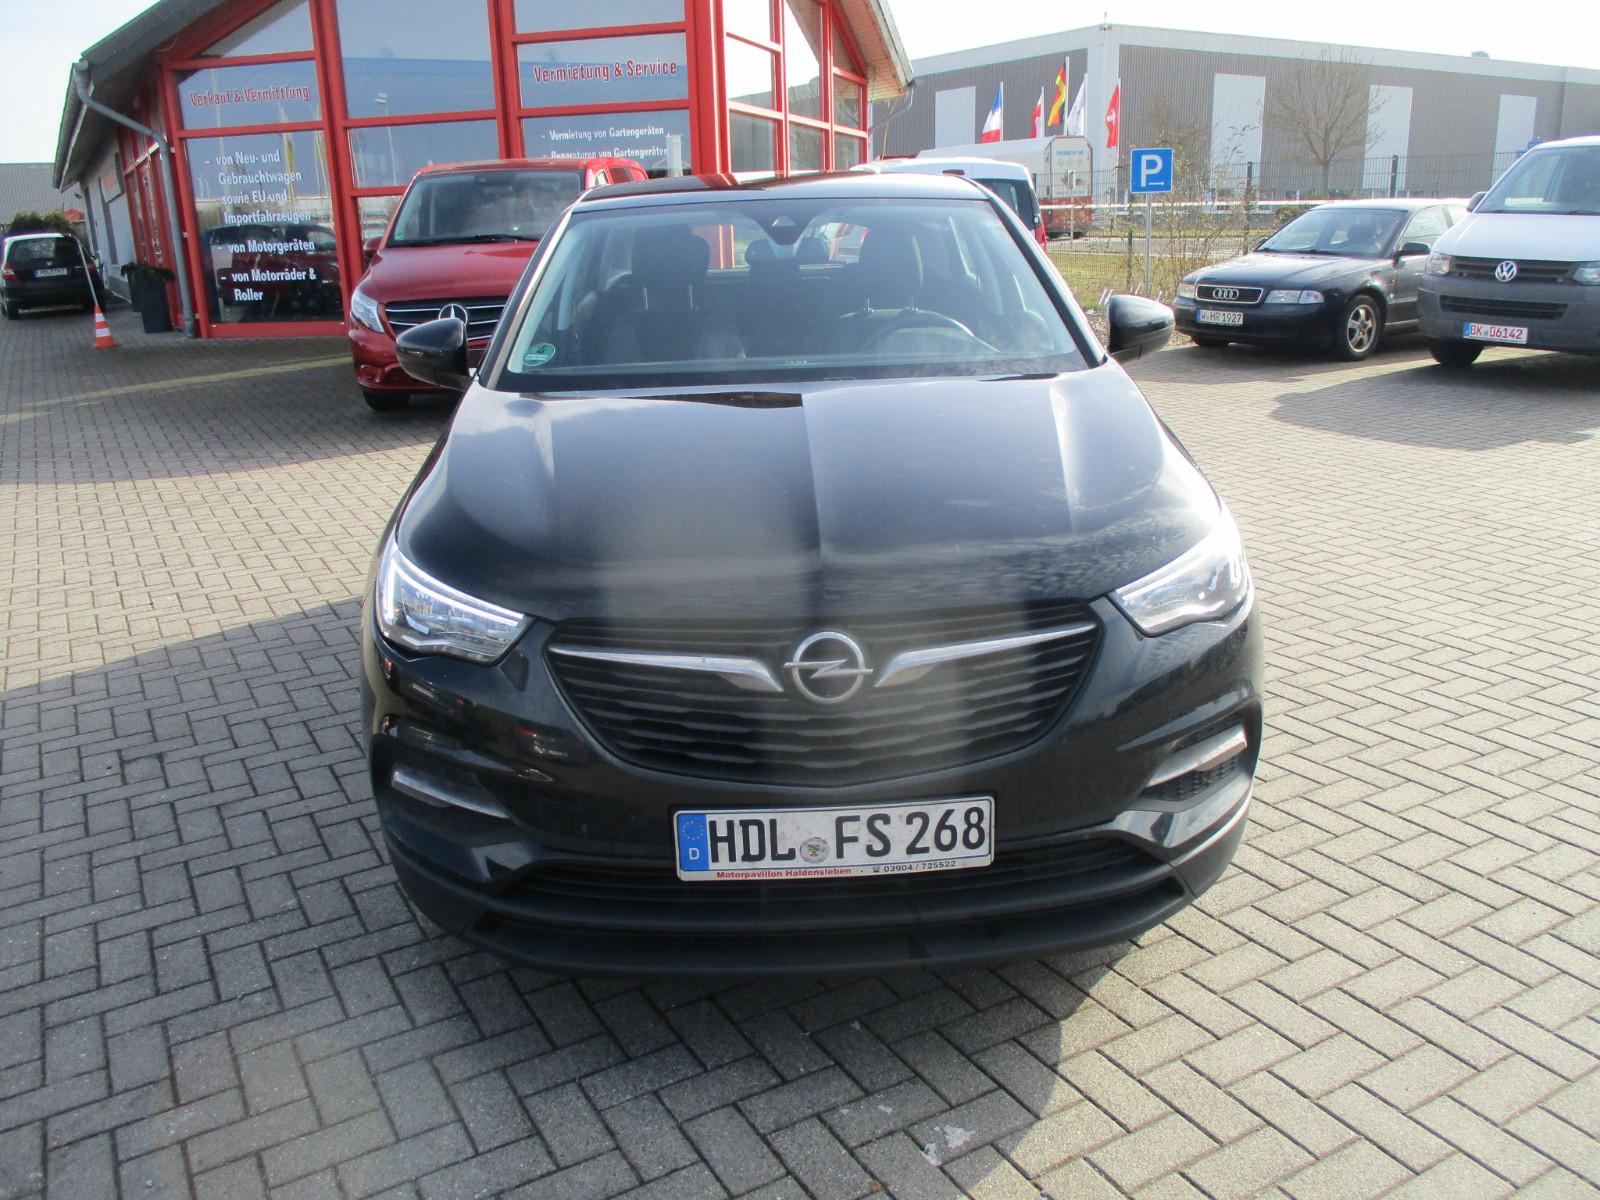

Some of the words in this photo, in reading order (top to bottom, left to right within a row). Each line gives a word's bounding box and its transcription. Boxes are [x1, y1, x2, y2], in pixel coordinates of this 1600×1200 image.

[533, 64, 610, 83] Vermietung
[614, 62, 623, 77] &
[627, 59, 677, 77] Service
[190, 89, 230, 106] Verkauf
[234, 89, 241, 103] &
[244, 84, 310, 103] Vermittlung
[549, 130, 592, 141] Vermietung
[594, 130, 607, 140] von
[609, 125, 664, 139] Gartengeräten
[216, 155, 233, 166] von
[235, 152, 259, 165] Neu-
[262, 149, 280, 163] und
[613, 146, 669, 159] Gartengeräten
[218, 171, 302, 185] Gebrauchtwagen
[1140, 154, 1163, 187] P
[223, 191, 249, 205] sowie
[224, 210, 312, 227] Importfahrzeugen
[228, 244, 246, 253] von
[247, 239, 315, 254] Motorgeräten
[232, 272, 249, 282] von
[251, 268, 307, 281] Motorräder
[309, 268, 317, 280] &
[234, 288, 263, 301] Roller
[1222, 312, 1242, 323] 1927
[708, 818, 796, 863] HDL
[835, 813, 891, 859] FS
[905, 806, 985, 855] 268
[688, 847, 700, 860] D
[716, 870, 783, 879] Motorpavillon
[785, 868, 851, 878] Haldensleben
[883, 864, 913, 873] 03904
[921, 861, 956, 870] 725522
